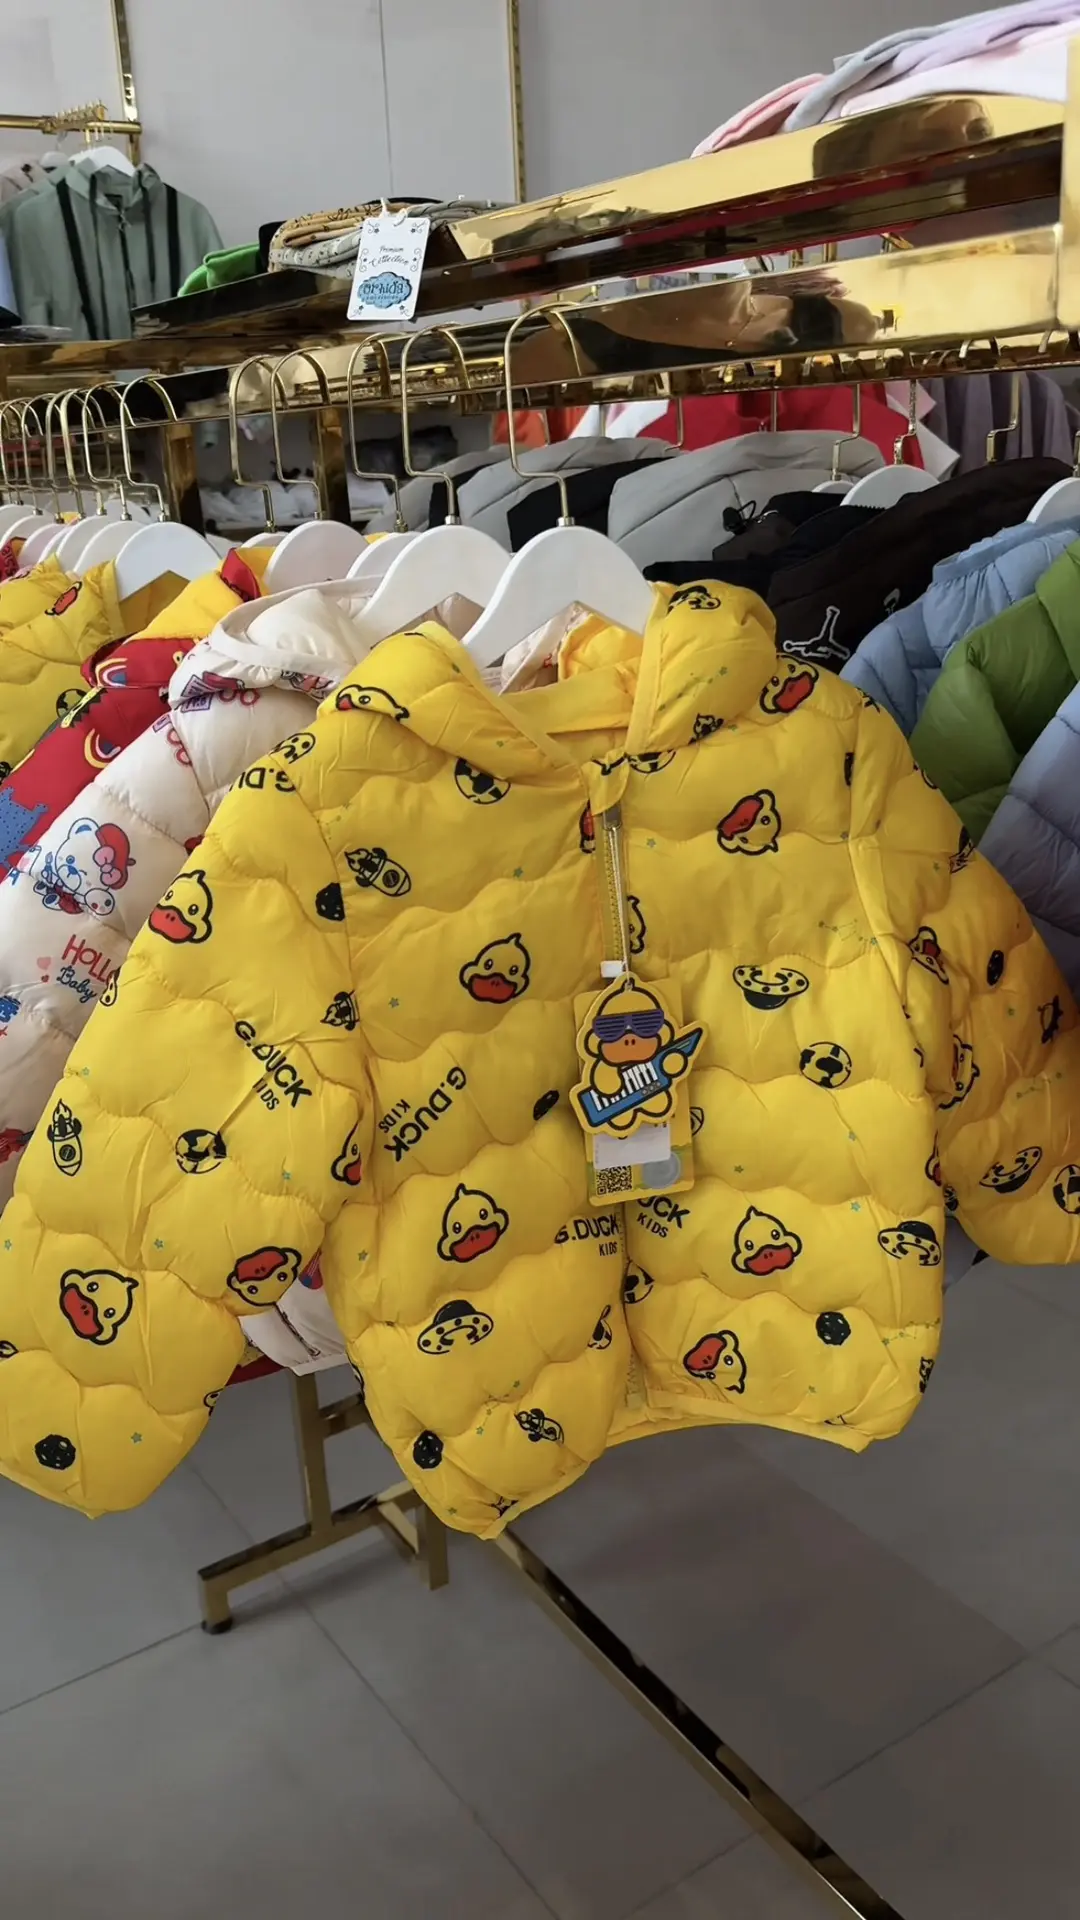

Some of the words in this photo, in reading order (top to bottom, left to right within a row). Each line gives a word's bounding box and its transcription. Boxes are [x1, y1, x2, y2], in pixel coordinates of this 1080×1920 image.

[368, 254, 410, 267] Collection
[379, 245, 404, 253] Premium
[56, 965, 97, 1003] Baby
[234, 1020, 312, 1108] G.DUCK
[378, 1098, 411, 1133] KIDS
[384, 1066, 467, 1162] G.DUCK
[637, 1212, 669, 1238] KIDS
[598, 1241, 618, 1257] KIDS
